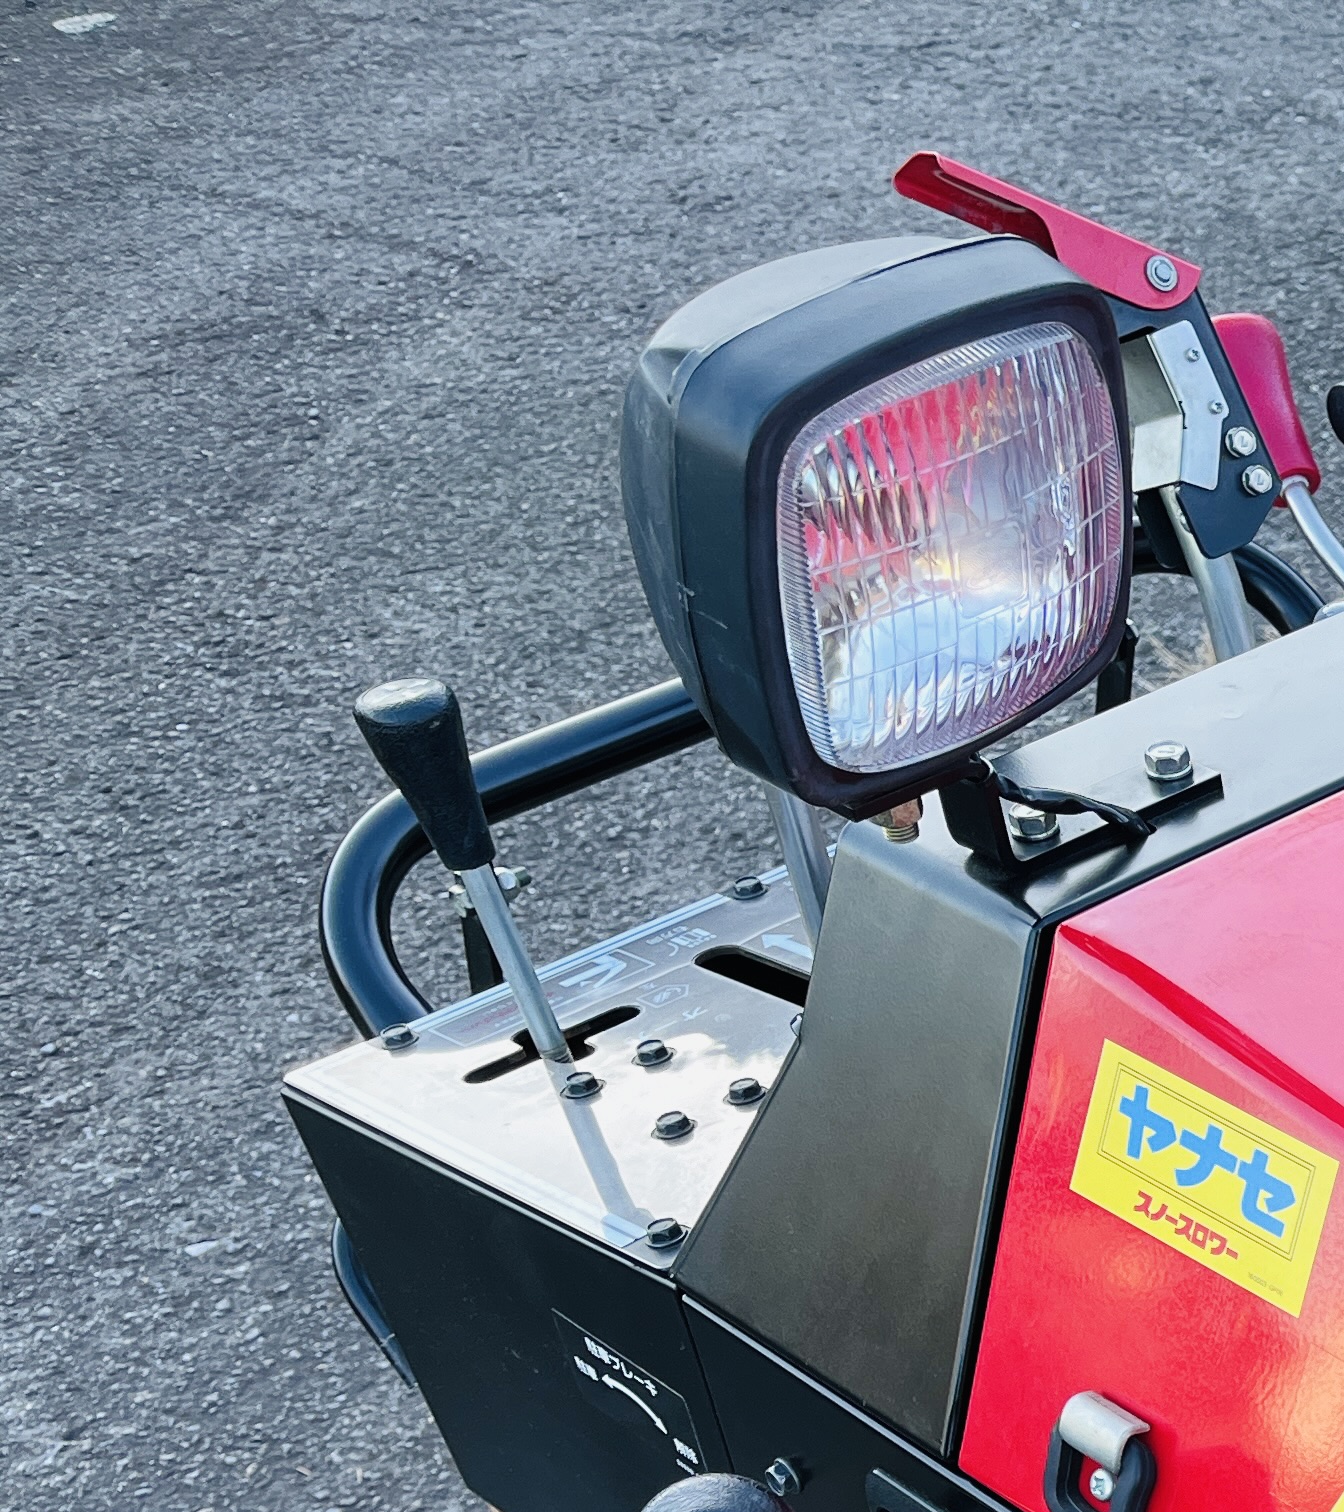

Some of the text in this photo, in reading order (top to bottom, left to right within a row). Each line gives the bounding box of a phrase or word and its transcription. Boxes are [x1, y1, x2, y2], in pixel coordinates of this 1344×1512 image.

[1118, 1084, 1296, 1238] ヤナセ
[1134, 1190, 1239, 1260] スノースロワー
